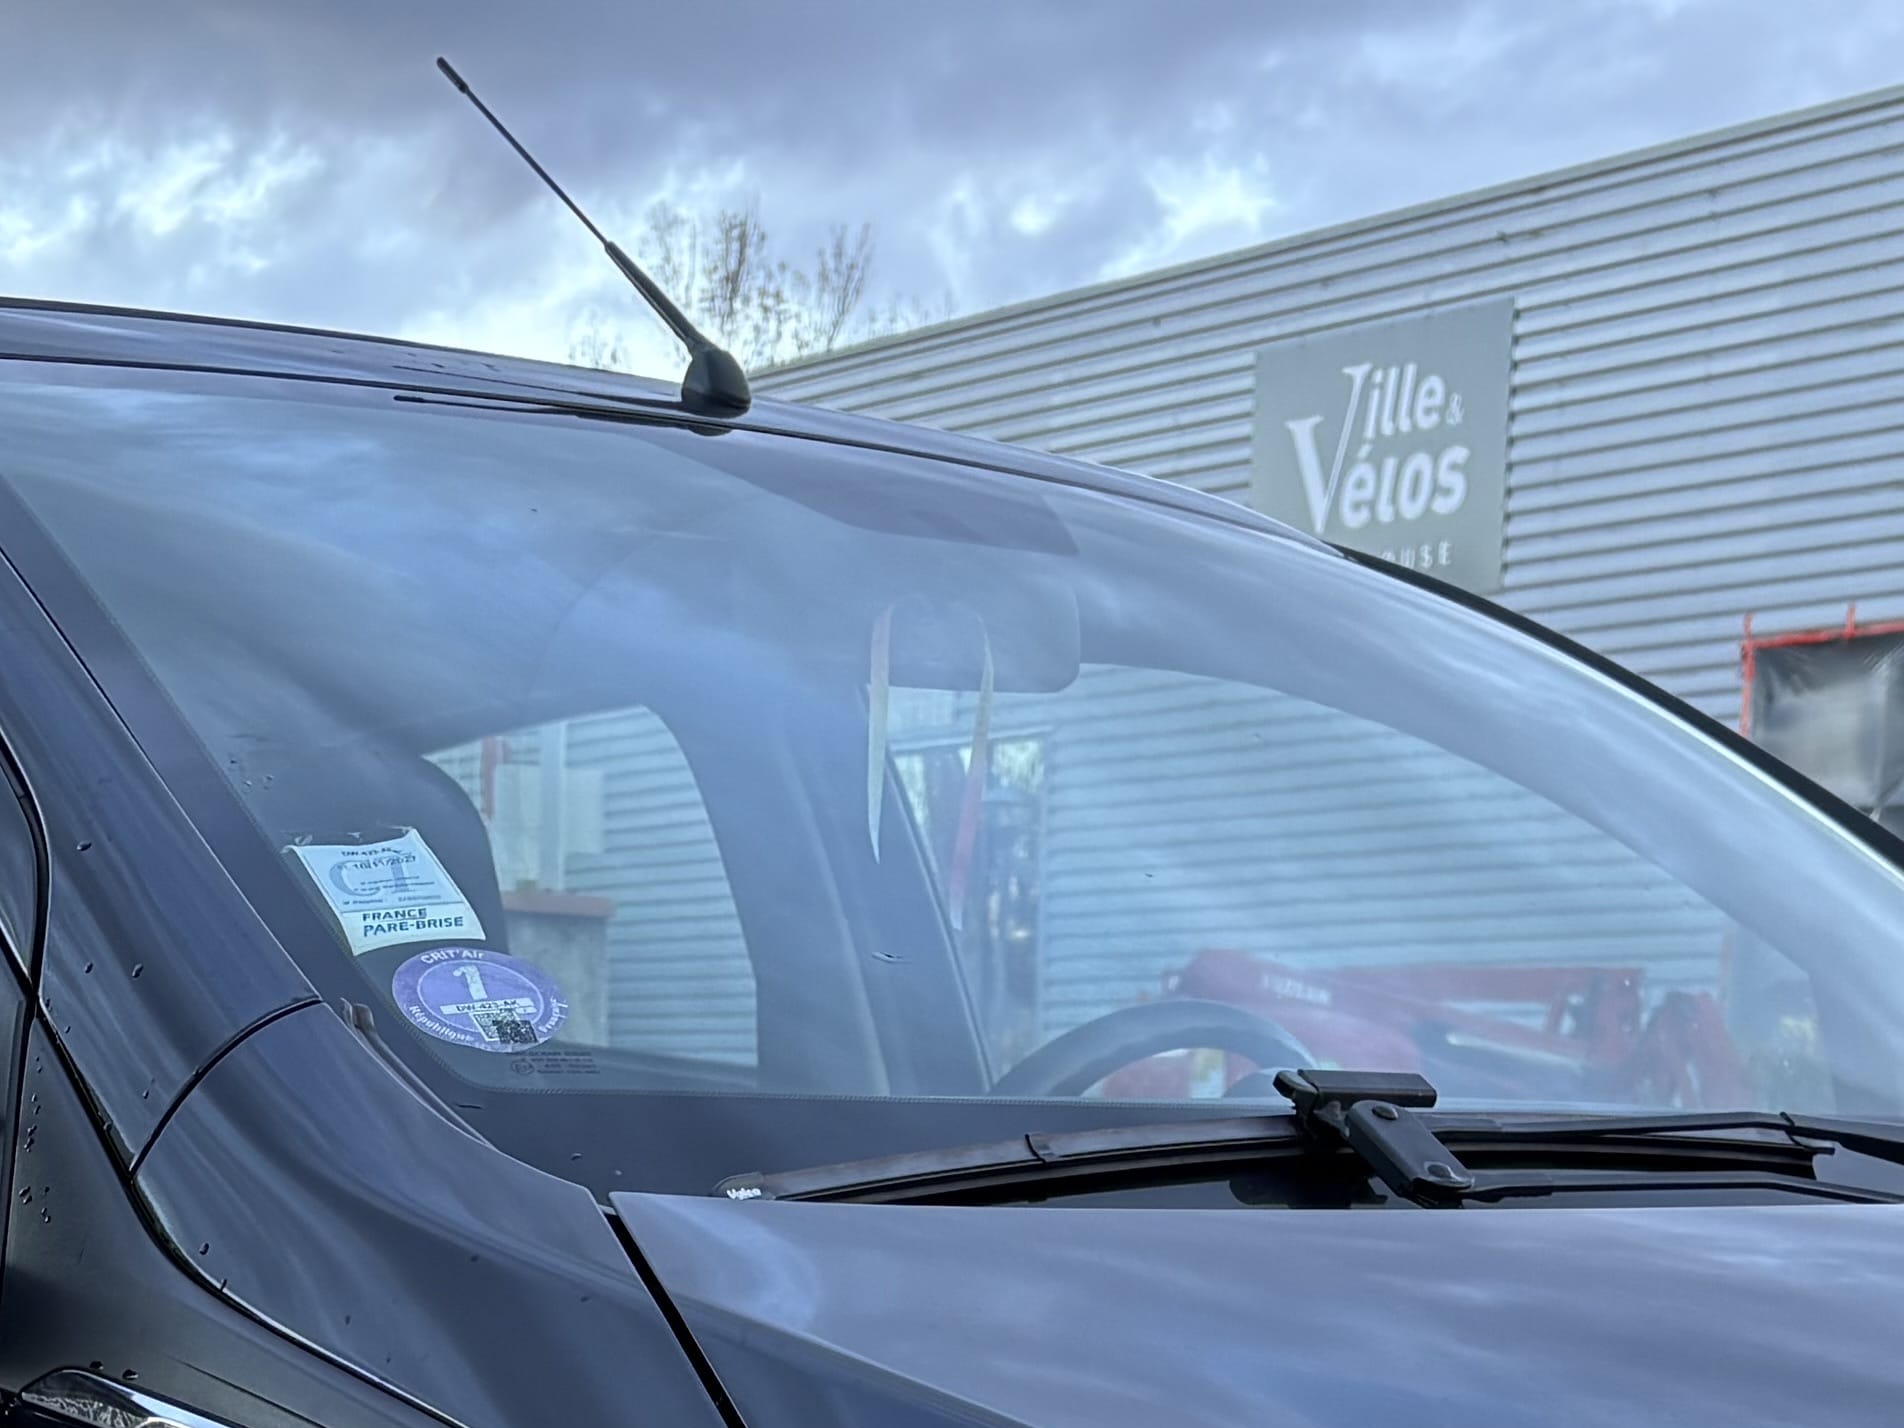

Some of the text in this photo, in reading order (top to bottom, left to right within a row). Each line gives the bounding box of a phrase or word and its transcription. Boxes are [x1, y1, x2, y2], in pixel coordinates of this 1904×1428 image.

[362, 908, 428, 922] FRANCE
[363, 916, 464, 938] PARE-BRISE
[452, 964, 489, 1001] 1
